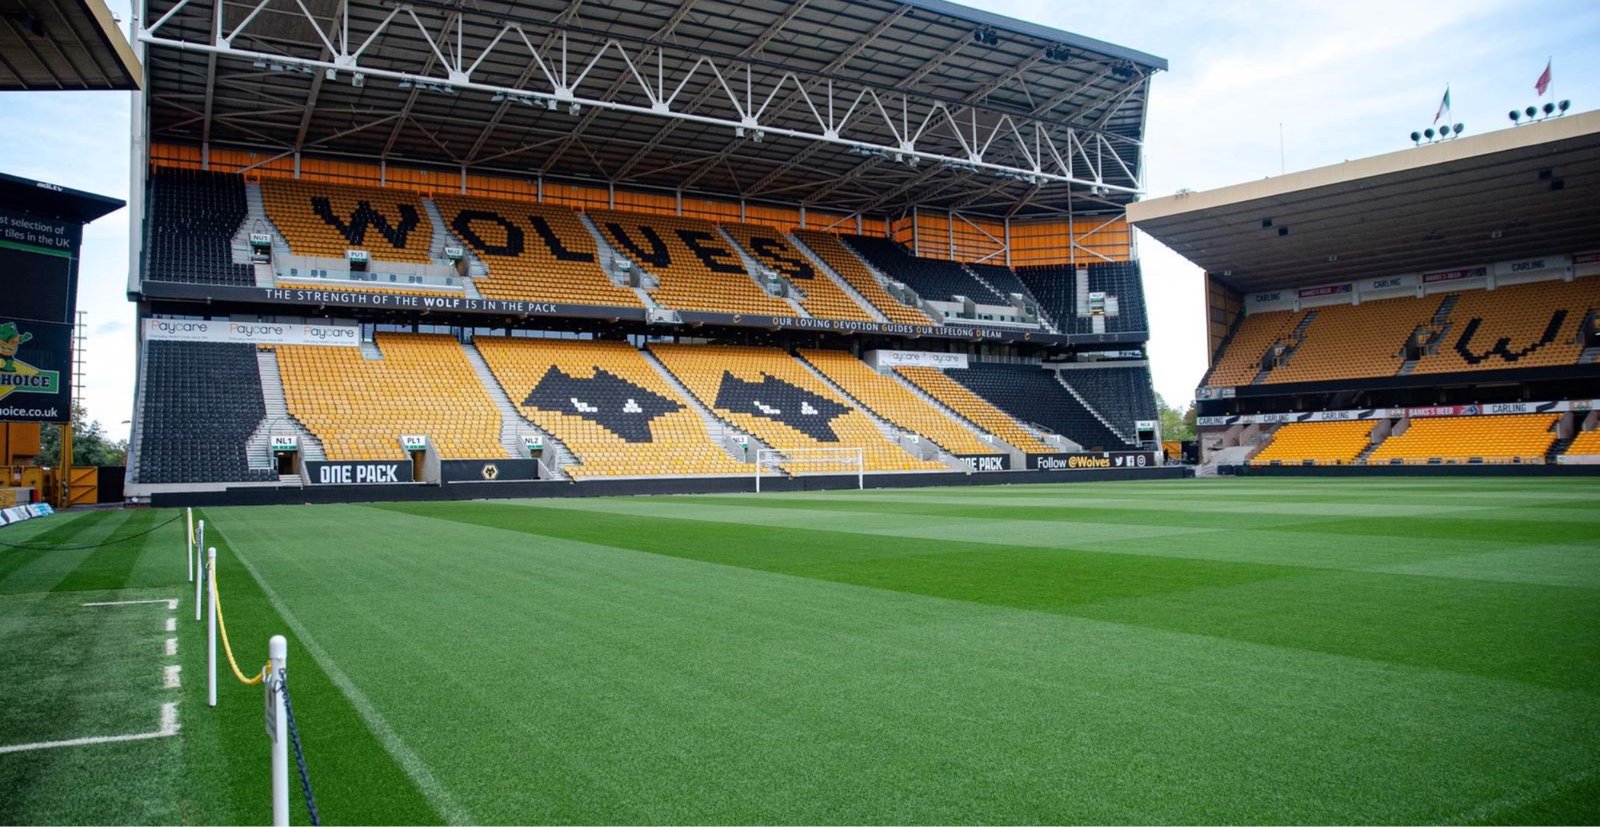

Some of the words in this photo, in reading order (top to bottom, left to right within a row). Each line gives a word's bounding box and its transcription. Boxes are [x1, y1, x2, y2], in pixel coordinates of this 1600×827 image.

[11, 218, 53, 233] selection
[55, 226, 65, 235] of
[5, 228, 25, 240] tiles
[27, 232, 36, 242] in
[38, 235, 54, 245] the
[56, 238, 71, 248] UK
[311, 196, 815, 280] WOLVES
[1512, 259, 1545, 272] CARLING
[1373, 278, 1401, 289] CARLING
[265, 289, 291, 300] THE
[297, 290, 367, 303] STRENGTH
[373, 294, 389, 305] OF
[395, 295, 418, 306] THE
[424, 297, 460, 308] WOLF
[465, 299, 477, 310] IS
[483, 300, 496, 310] IN
[502, 301, 523, 311] THE
[528, 302, 557, 313] PACK
[1256, 292, 1281, 303] CARLING
[151, 320, 208, 334] Paycare
[229, 321, 283, 337] Paycare
[303, 325, 355, 339] Paycare
[772, 317, 792, 326] OUR
[796, 318, 830, 328] LOVING
[833, 320, 879, 331] DEVOTION
[881, 324, 913, 334] GUIDES
[916, 326, 933, 335] OUR
[935, 327, 973, 337] LIFELONG
[976, 329, 1002, 338] DREAM
[1322, 410, 1349, 420] CARLING
[1436, 407, 1453, 415] BEER
[1493, 404, 1526, 413] CARLING
[1199, 416, 1224, 425] CARLING
[1263, 413, 1290, 423] CARLING
[525, 436, 539, 444] NL2
[979, 457, 1003, 470] PACK
[1037, 456, 1066, 469] Follow
[1068, 456, 1110, 468] @Wolves
[320, 465, 352, 483] ONE
[357, 465, 398, 483] PACK
